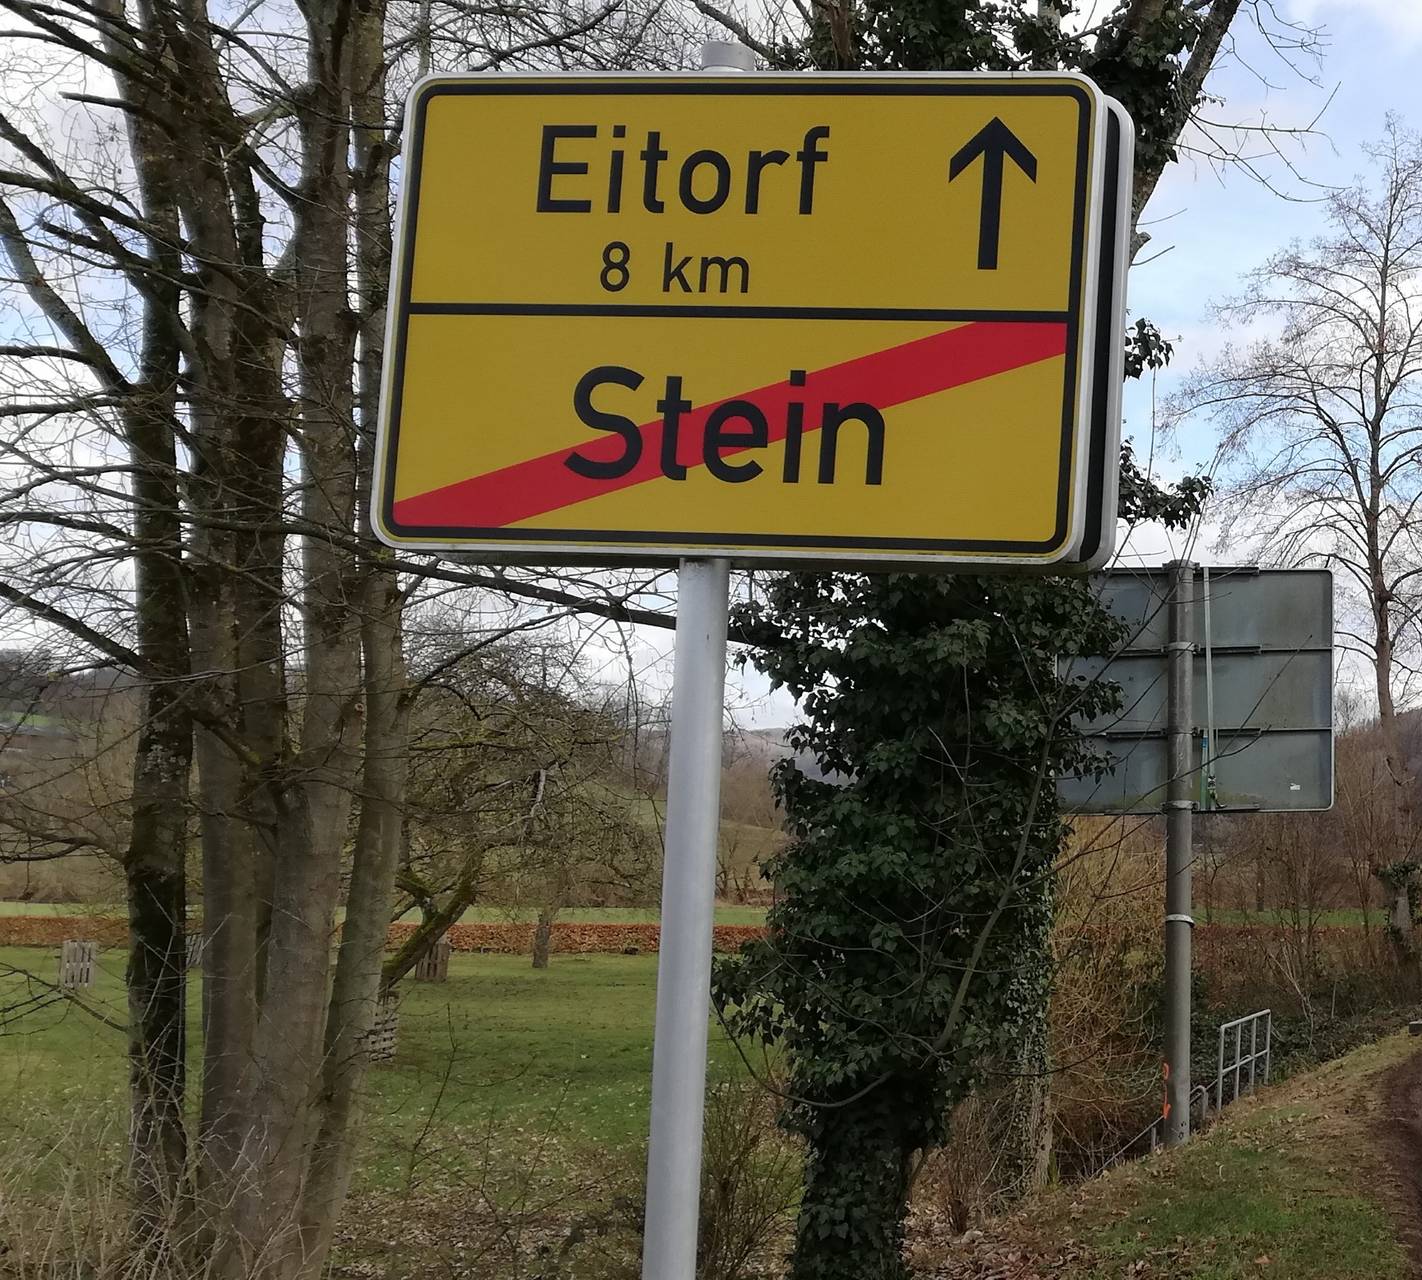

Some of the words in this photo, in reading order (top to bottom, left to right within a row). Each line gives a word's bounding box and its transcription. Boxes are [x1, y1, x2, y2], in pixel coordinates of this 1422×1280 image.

[536, 124, 830, 215] Eitorf
[600, 240, 631, 292] 8
[662, 241, 751, 294] km
[563, 364, 886, 486] Stein
